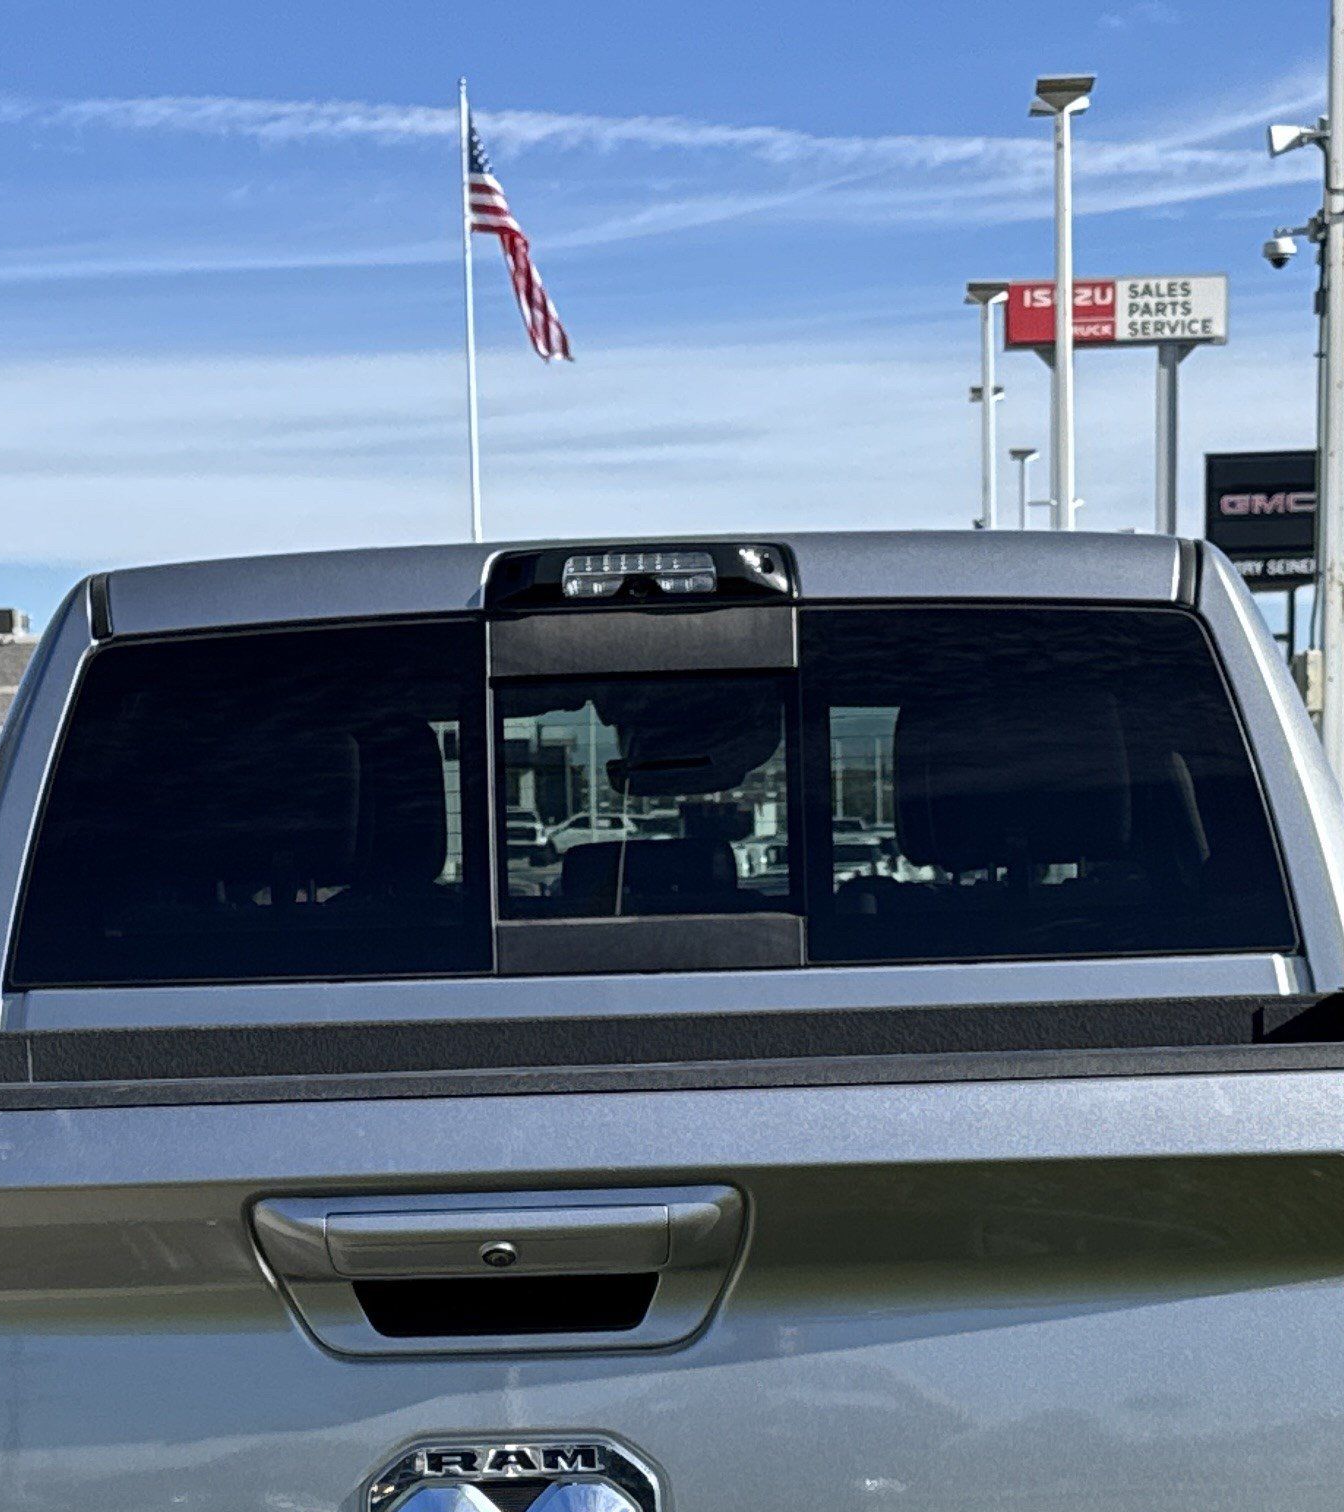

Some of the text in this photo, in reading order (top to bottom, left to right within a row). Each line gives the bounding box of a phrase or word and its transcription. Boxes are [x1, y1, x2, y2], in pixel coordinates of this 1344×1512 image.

[1022, 287, 1113, 308] ISZU
[1128, 281, 1191, 299] SALES
[1128, 301, 1192, 317] PARTS
[1073, 324, 1113, 336] RUCK
[1128, 319, 1214, 336] SERVICE
[1220, 492, 1316, 515] GMC
[415, 1446, 605, 1479] RAM
